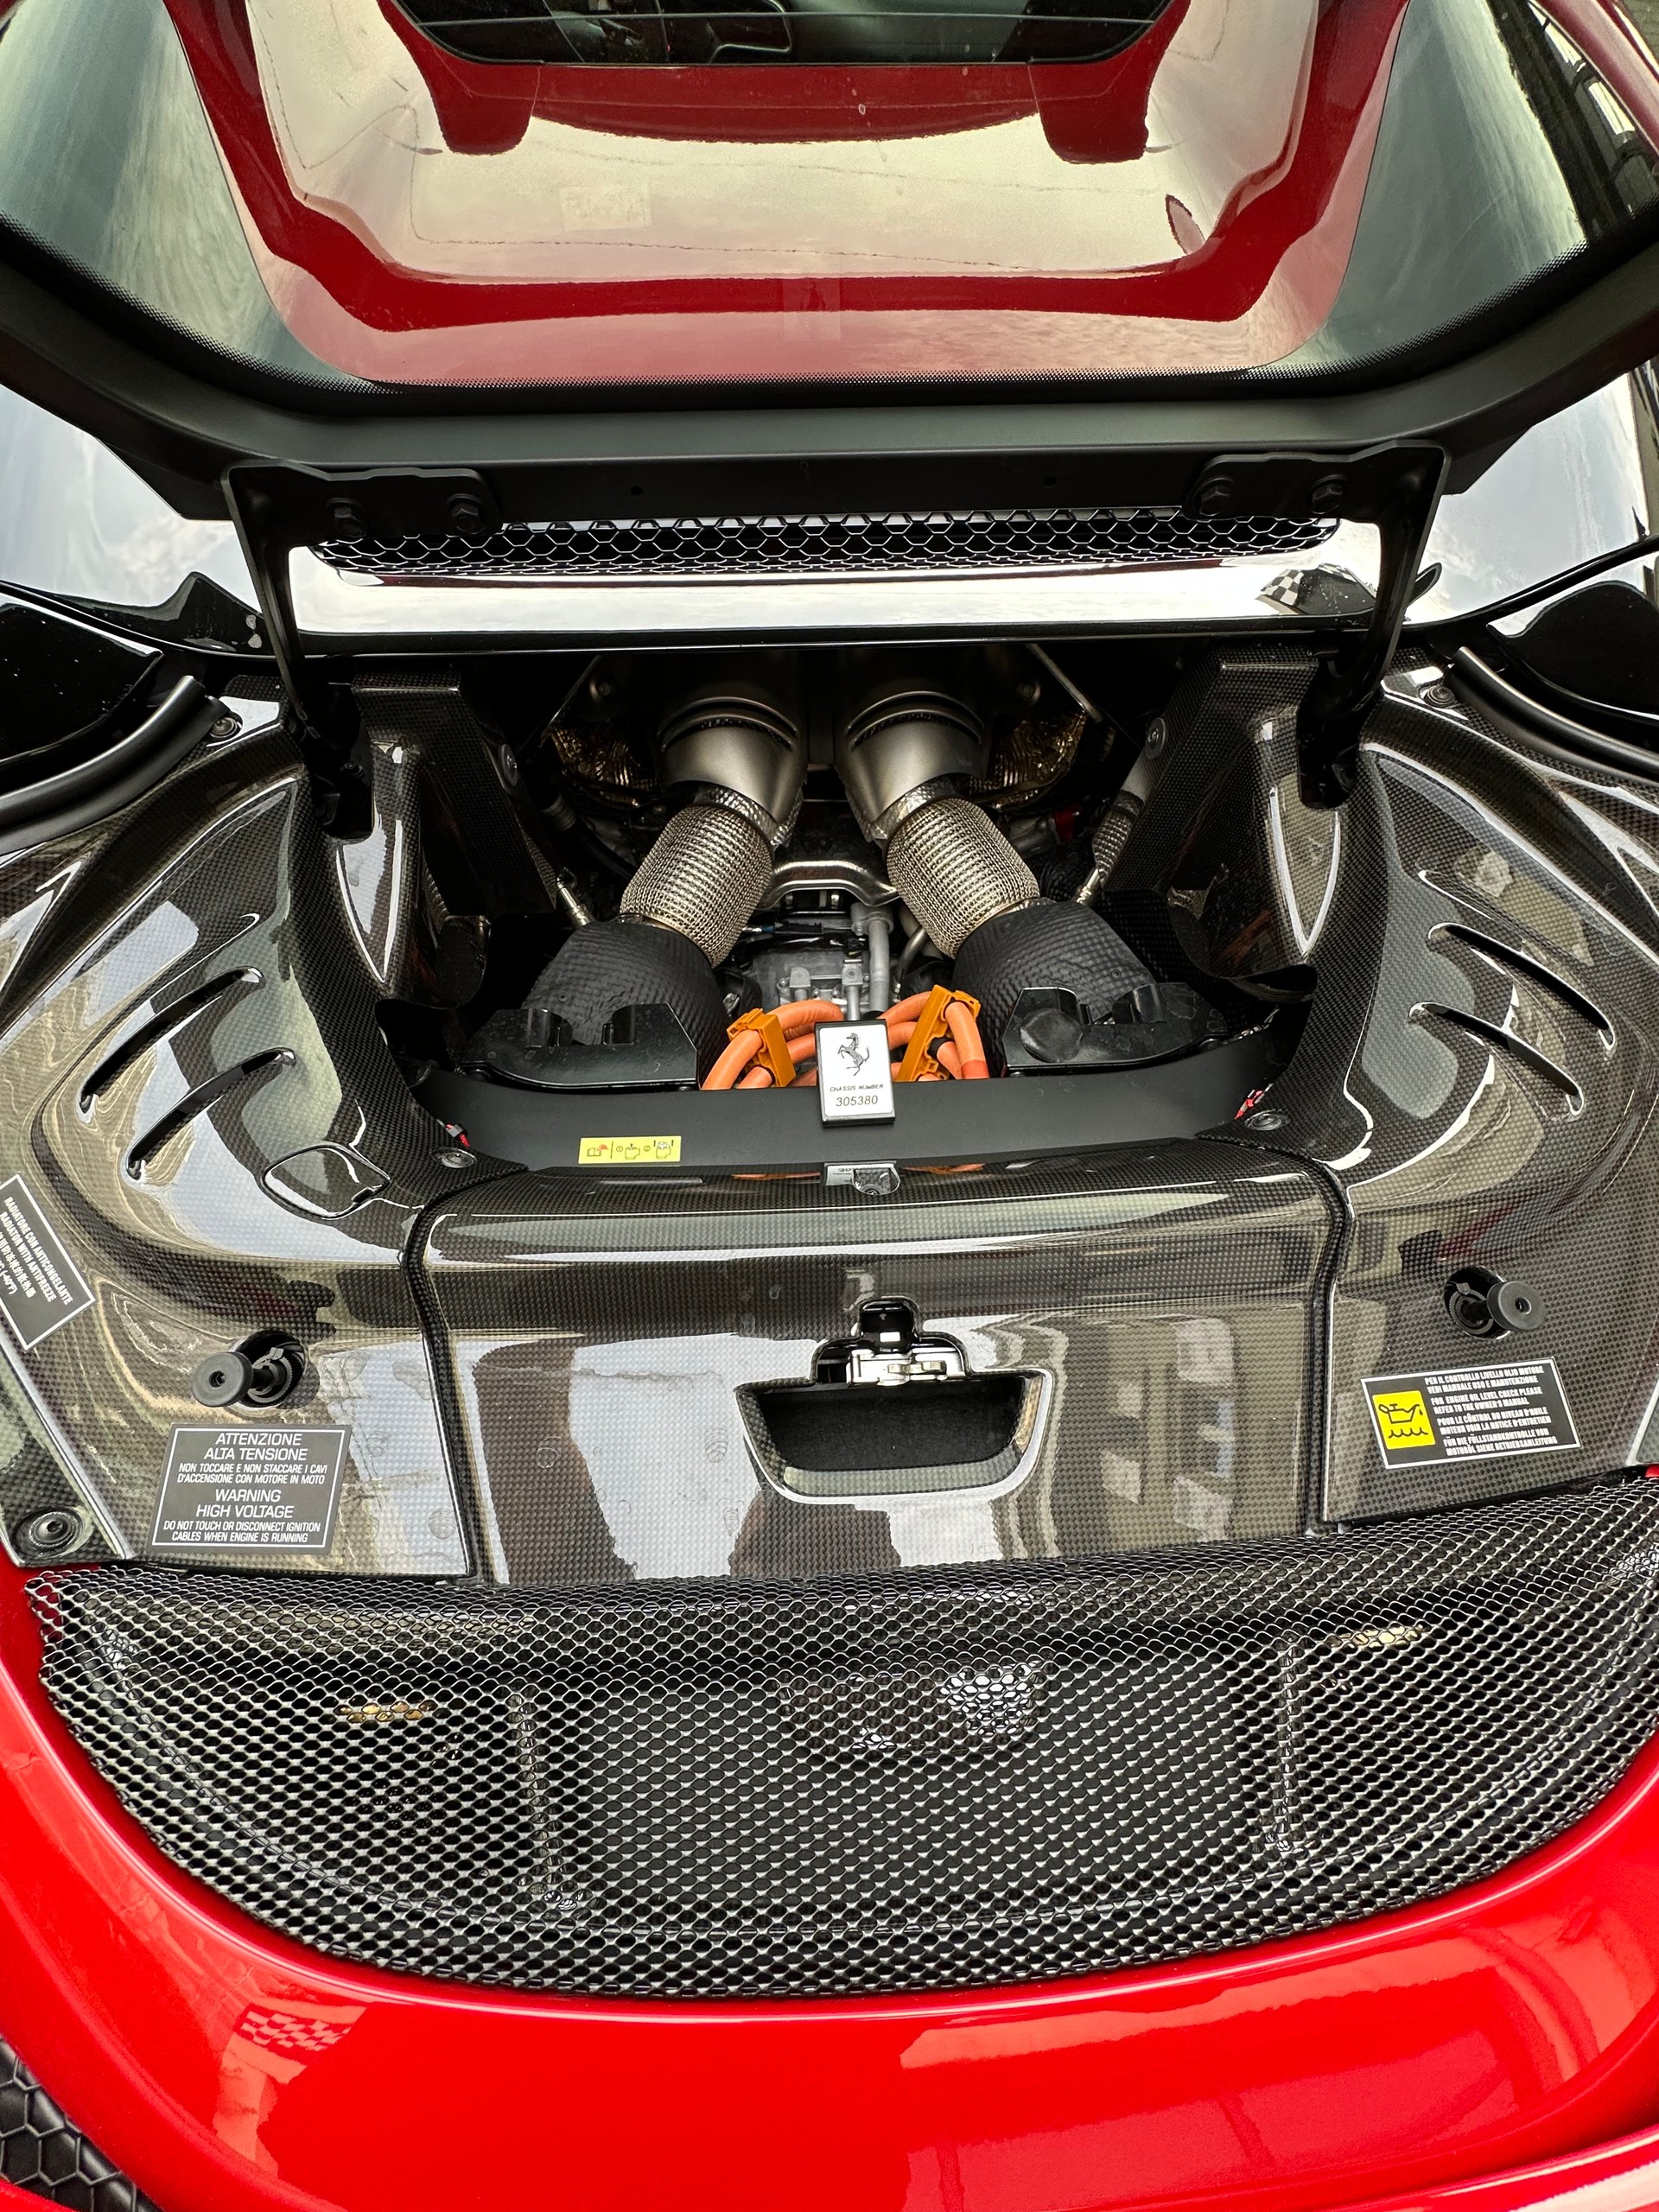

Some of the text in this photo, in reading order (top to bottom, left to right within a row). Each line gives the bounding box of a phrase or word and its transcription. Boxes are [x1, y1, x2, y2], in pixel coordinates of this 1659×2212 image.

[836, 1096, 878, 1107] 305380
[0, 1211, 57, 1302] RADIATOR WITH ANTIFREEZE
[3, 1197, 73, 1305] RADIATORE CON ANTICONGELANTE
[215, 1433, 302, 1446] ATTENZIONE
[204, 1447, 308, 1460] ALTA TENSIONE
[178, 1463, 327, 1473] NON TOCCARE E NON STACCARE I CAVI
[177, 1473, 325, 1484] D'ACCENSIONE CON MOTORE IN MOTO
[215, 1489, 282, 1502] WARNING
[195, 1504, 295, 1518] HIGH VOLTAGE
[163, 1520, 321, 1532] DO NOT TOUCH OR DISCONNECT IGNITION
[172, 1531, 308, 1542] CABLES WHEN ENGINE IS RUNNING
